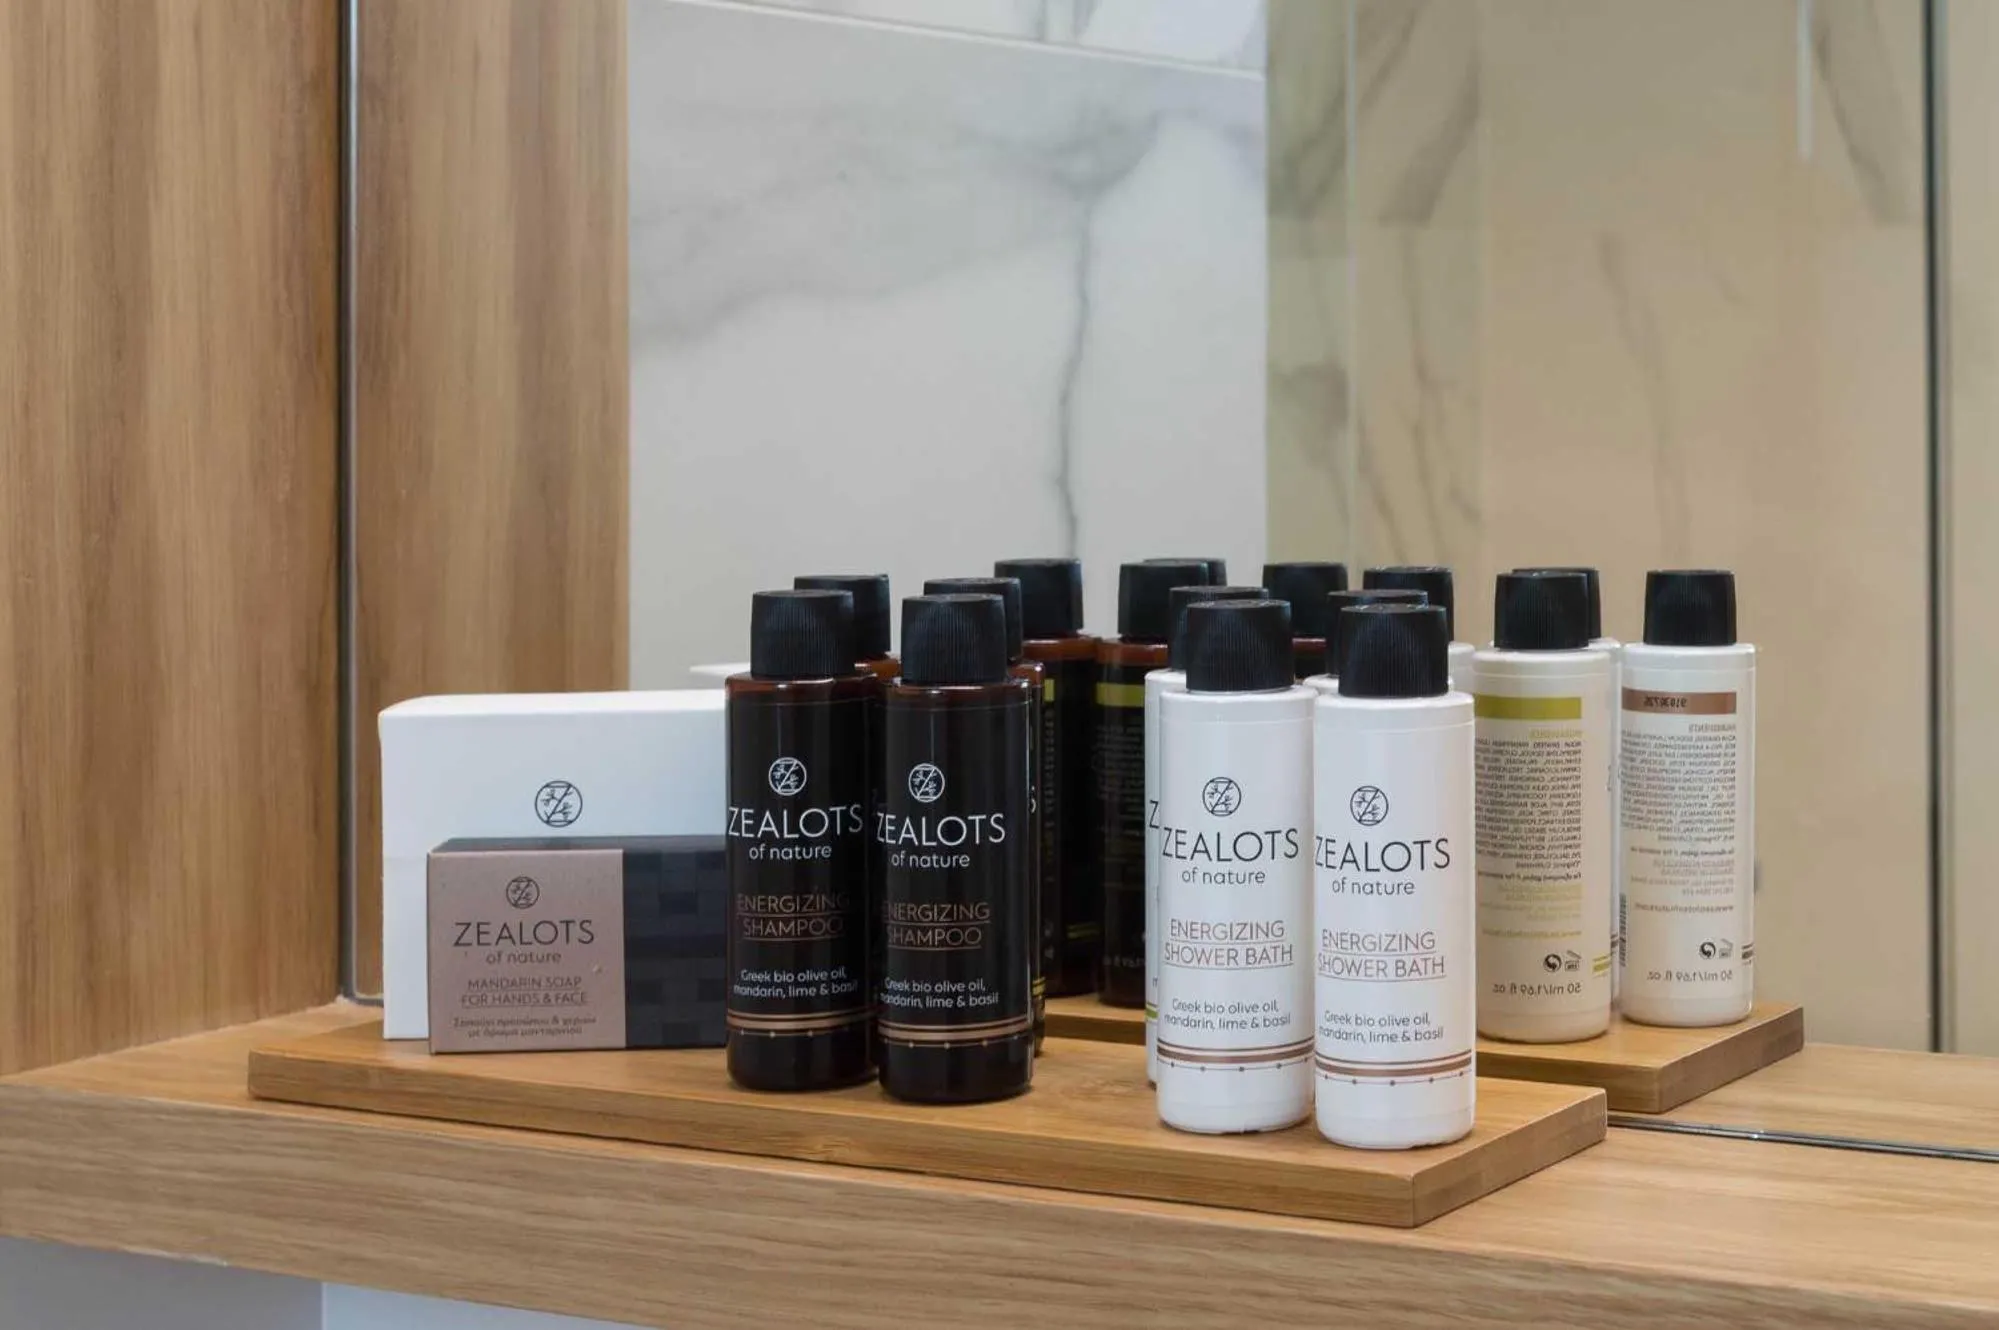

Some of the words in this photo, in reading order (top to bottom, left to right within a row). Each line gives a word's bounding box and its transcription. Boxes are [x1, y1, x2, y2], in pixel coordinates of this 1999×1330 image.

[728, 804, 863, 839] ZEALOTS
[877, 811, 1006, 847] ZEALOTS
[749, 843, 767, 860] of
[769, 844, 832, 860] nature
[1162, 827, 1298, 862] ZEALOTS
[891, 850, 906, 866] of
[909, 853, 970, 868] nature
[1315, 836, 1450, 872] ZEALOTS
[1181, 867, 1198, 883] of
[1202, 870, 1265, 885] nature
[1332, 877, 1346, 894] of
[1351, 880, 1415, 896] nature
[737, 892, 850, 913] ENERGIZING
[453, 919, 594, 947] ZEALOTS
[743, 917, 845, 938] SHAMPOO
[1170, 919, 1284, 941] ENERGIZING
[1322, 929, 1435, 953] ENERGIZING
[486, 951, 502, 964] of
[507, 952, 561, 964] nature
[1165, 942, 1238, 966] SHOWER
[1245, 944, 1292, 965] BATH
[1318, 953, 1388, 978] SHOWER
[1395, 956, 1445, 978] BATH
[468, 977, 541, 991] MANDARIN
[543, 976, 582, 988] SOAP
[741, 969, 770, 983] Greek
[774, 969, 794, 983] bio
[797, 968, 828, 982] olive
[884, 977, 909, 992] Greek
[912, 979, 932, 992] bio
[935, 979, 965, 992] olive
[968, 978, 985, 992] oil,
[461, 994, 488, 1006] FOR
[492, 994, 540, 1004] HANDS
[543, 993, 551, 1003] &
[555, 992, 588, 1004] FACE
[733, 983, 786, 999] mandarin,
[788, 984, 817, 998] lime
[819, 985, 830, 997] &
[926, 995, 953, 1008] lime
[956, 995, 965, 1007] &
[969, 993, 999, 1007] basil
[1172, 998, 1200, 1013] Greek
[1204, 999, 1224, 1014] bio
[1228, 999, 1259, 1014] olive
[1164, 1013, 1215, 1031] mandarin,
[1218, 1016, 1248, 1030] lime
[1250, 1017, 1260, 1029] &
[1263, 1013, 1290, 1028] basil
[1324, 1010, 1352, 1025] Greek
[1355, 1013, 1375, 1027] bio
[1378, 1013, 1410, 1028] olive
[1413, 1012, 1430, 1027] oil,
[1369, 1029, 1399, 1043] lime
[1401, 1029, 1410, 1042] &
[1414, 1027, 1443, 1041] basil
